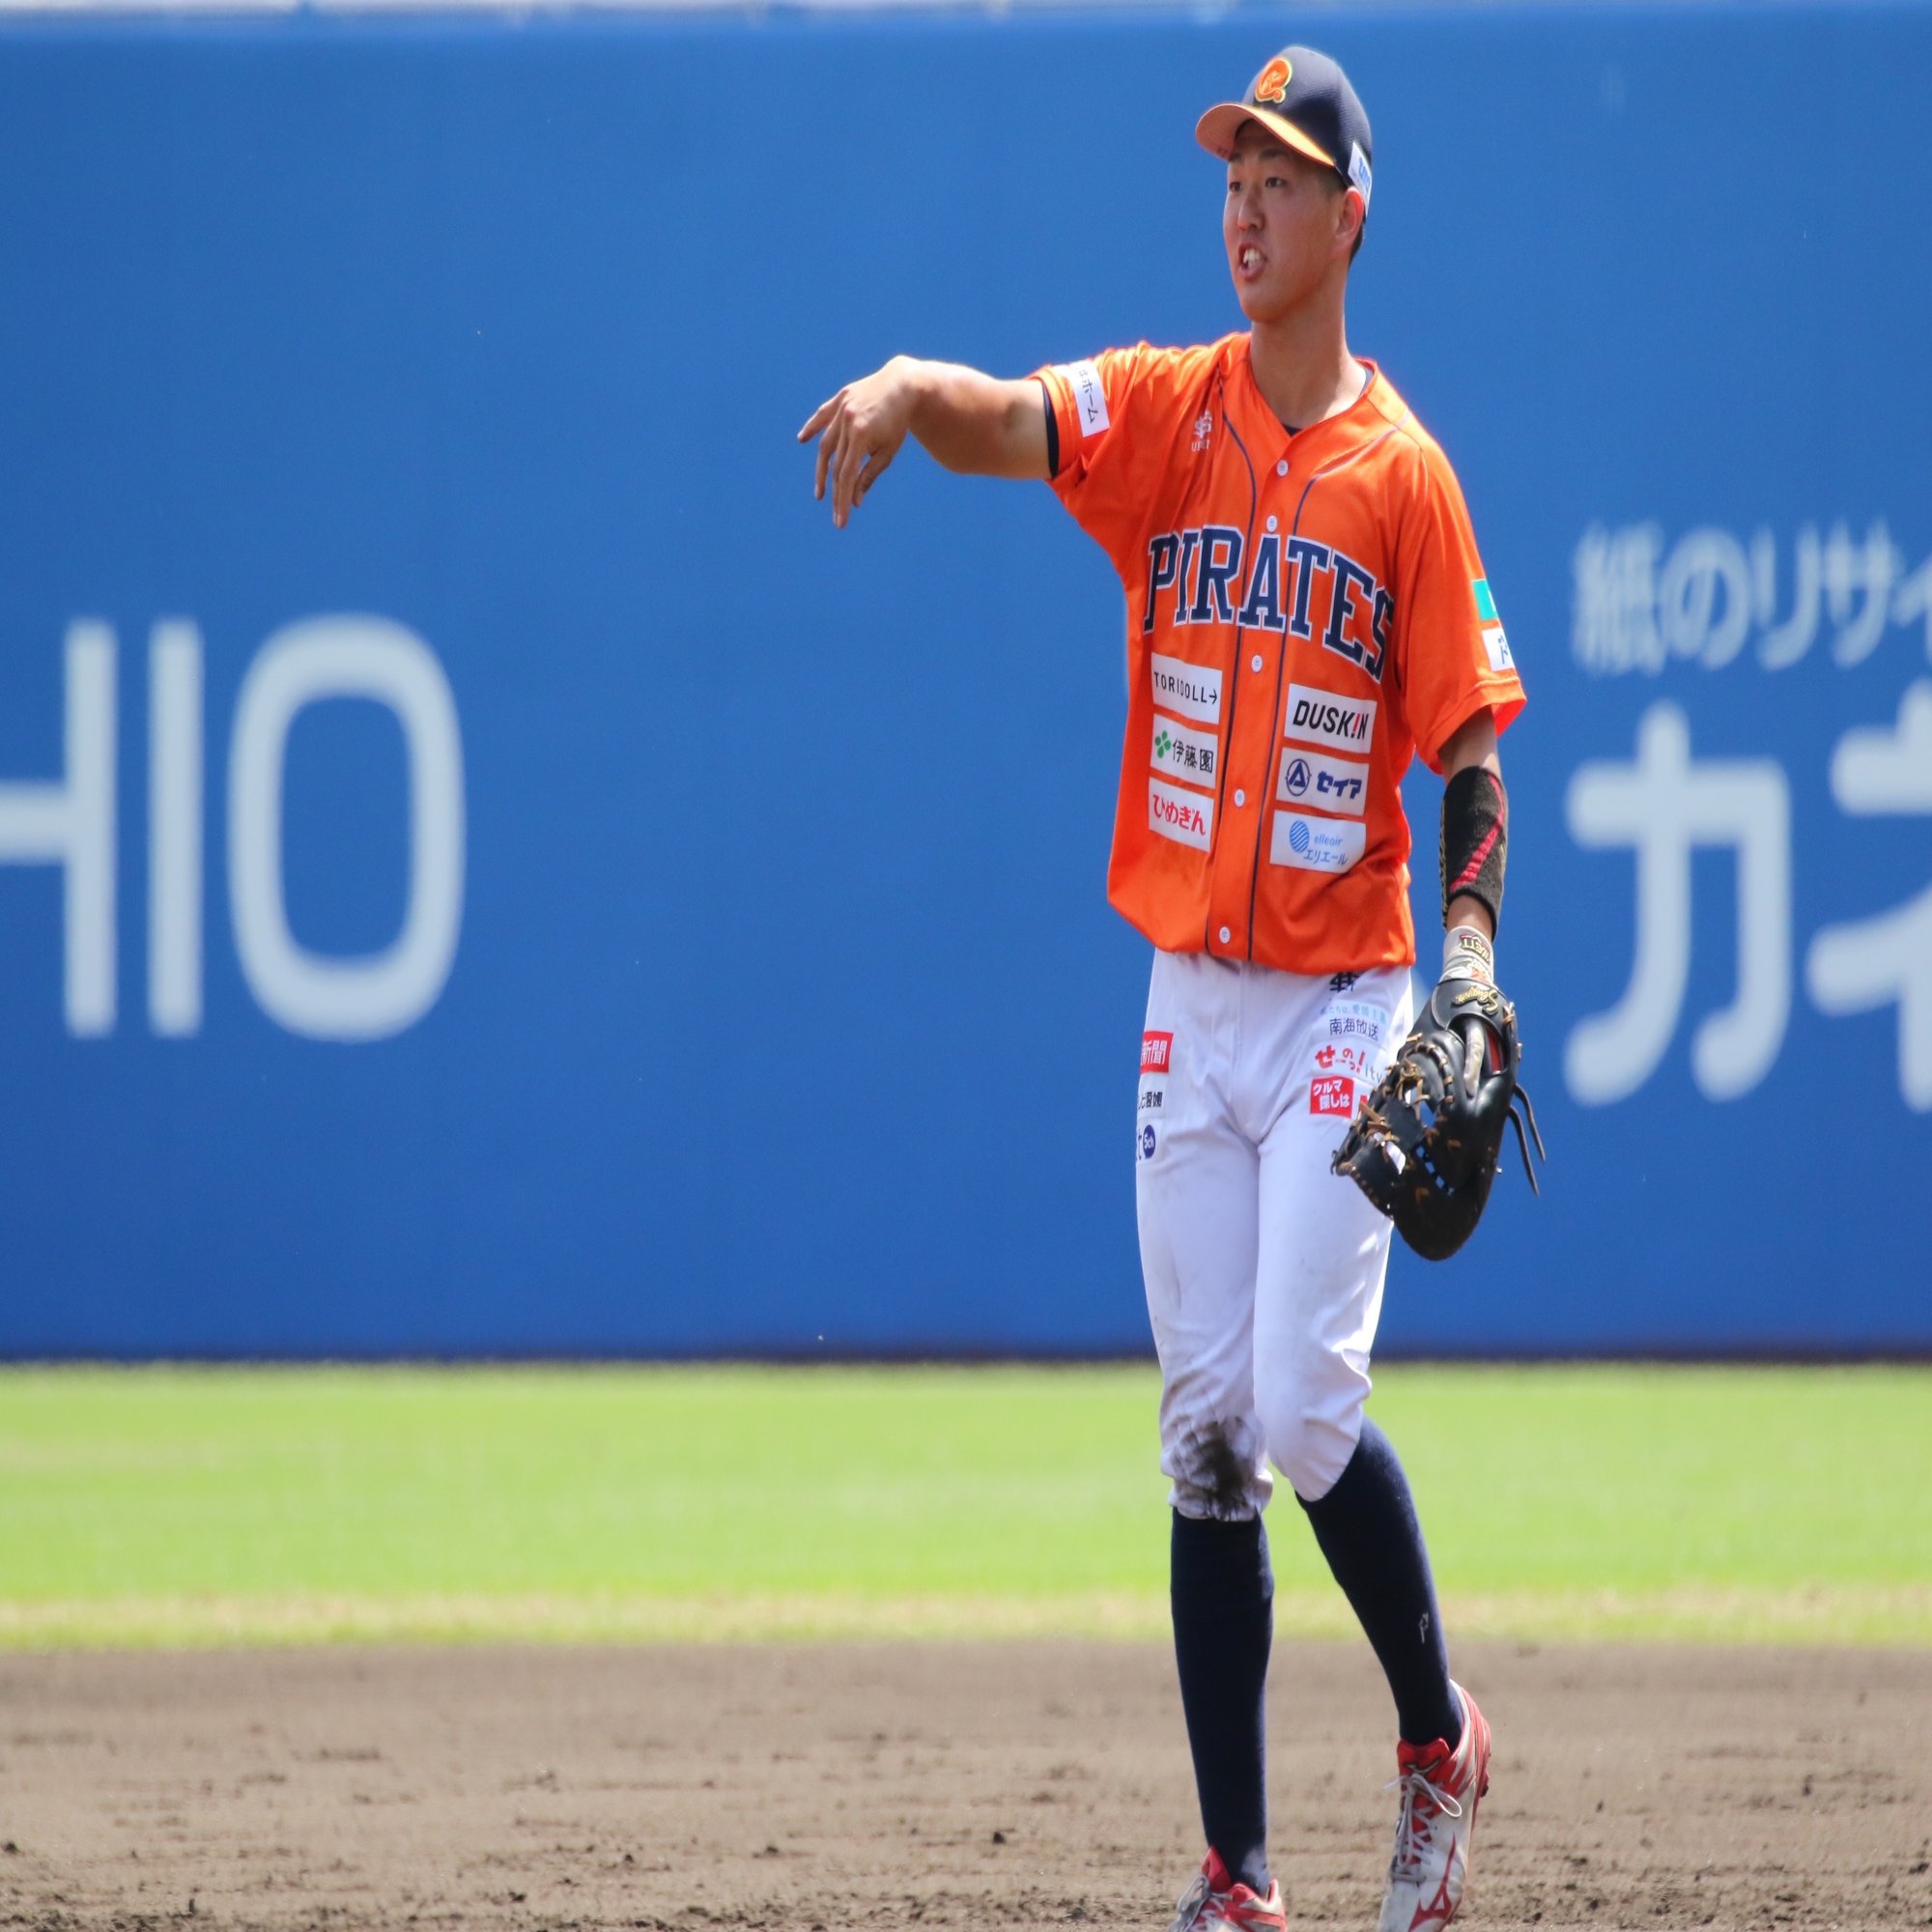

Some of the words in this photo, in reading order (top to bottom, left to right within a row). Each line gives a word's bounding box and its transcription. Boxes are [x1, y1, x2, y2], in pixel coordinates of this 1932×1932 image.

[1144, 525, 1394, 684] PIRATES
[1153, 671, 1208, 703] TORIDOLL
[1173, 738, 1214, 773] 伊藤園
[1317, 771, 1362, 799] セイア
[1152, 794, 1206, 836] ひめぎん
[1303, 848, 1349, 866] エリエール
[1329, 1017, 1379, 1041] 南海放送
[1313, 1078, 1344, 1096] クルマ
